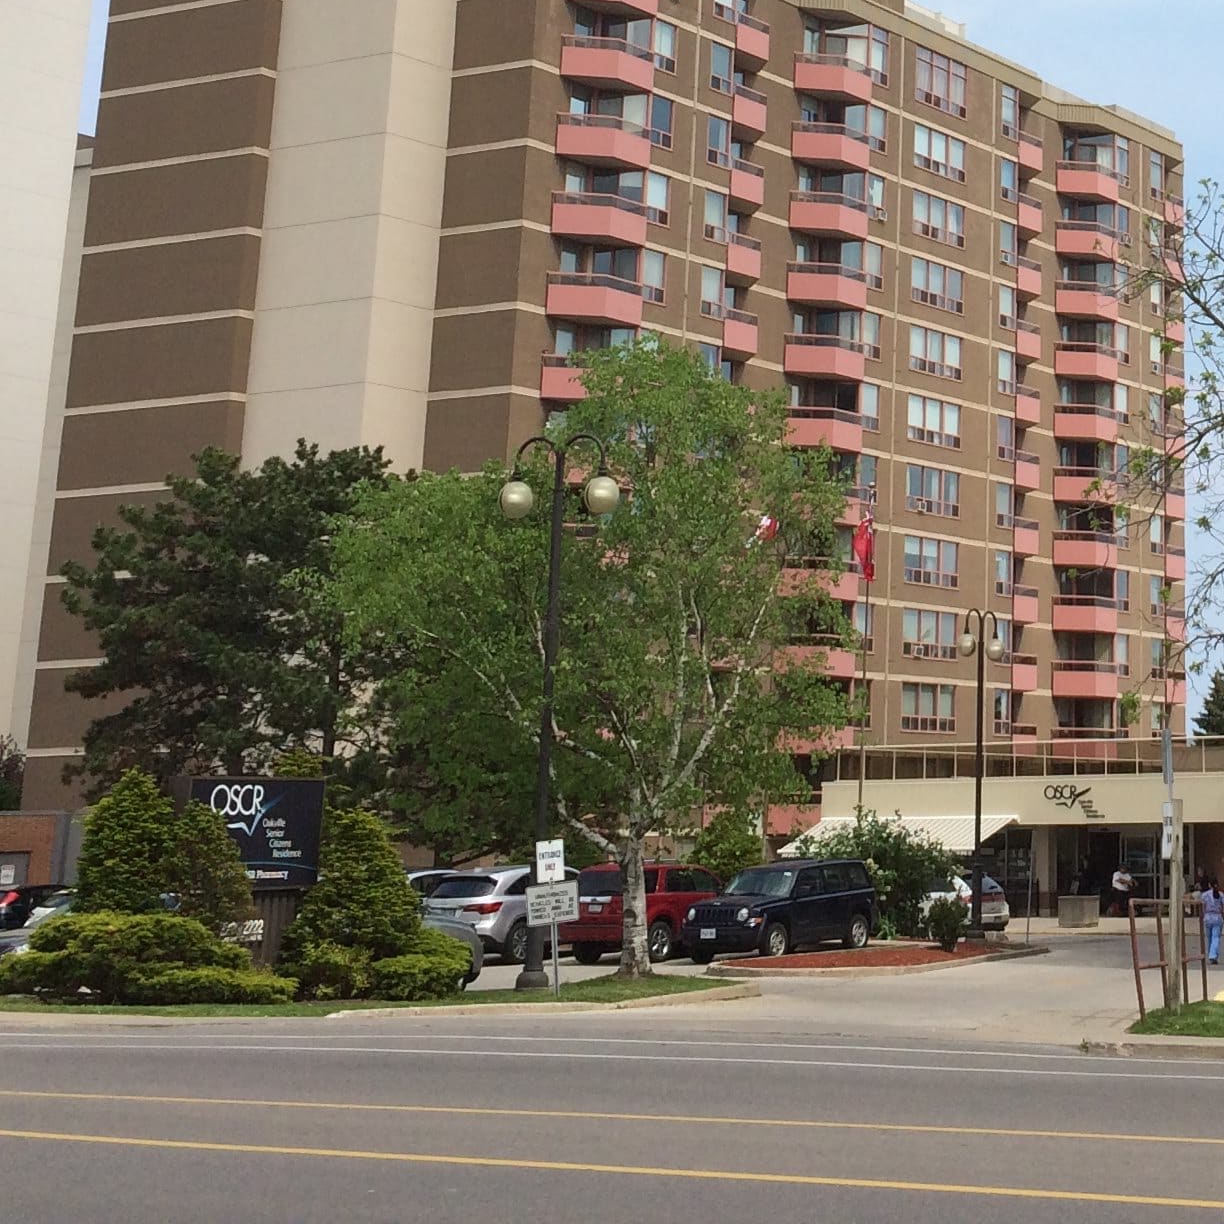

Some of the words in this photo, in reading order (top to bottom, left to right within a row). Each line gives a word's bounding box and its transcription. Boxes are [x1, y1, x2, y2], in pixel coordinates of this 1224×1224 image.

[1044, 785, 1078, 800] OSCR
[210, 784, 264, 816] OSCR
[265, 828, 285, 838] Senior
[272, 849, 302, 858] Residence
